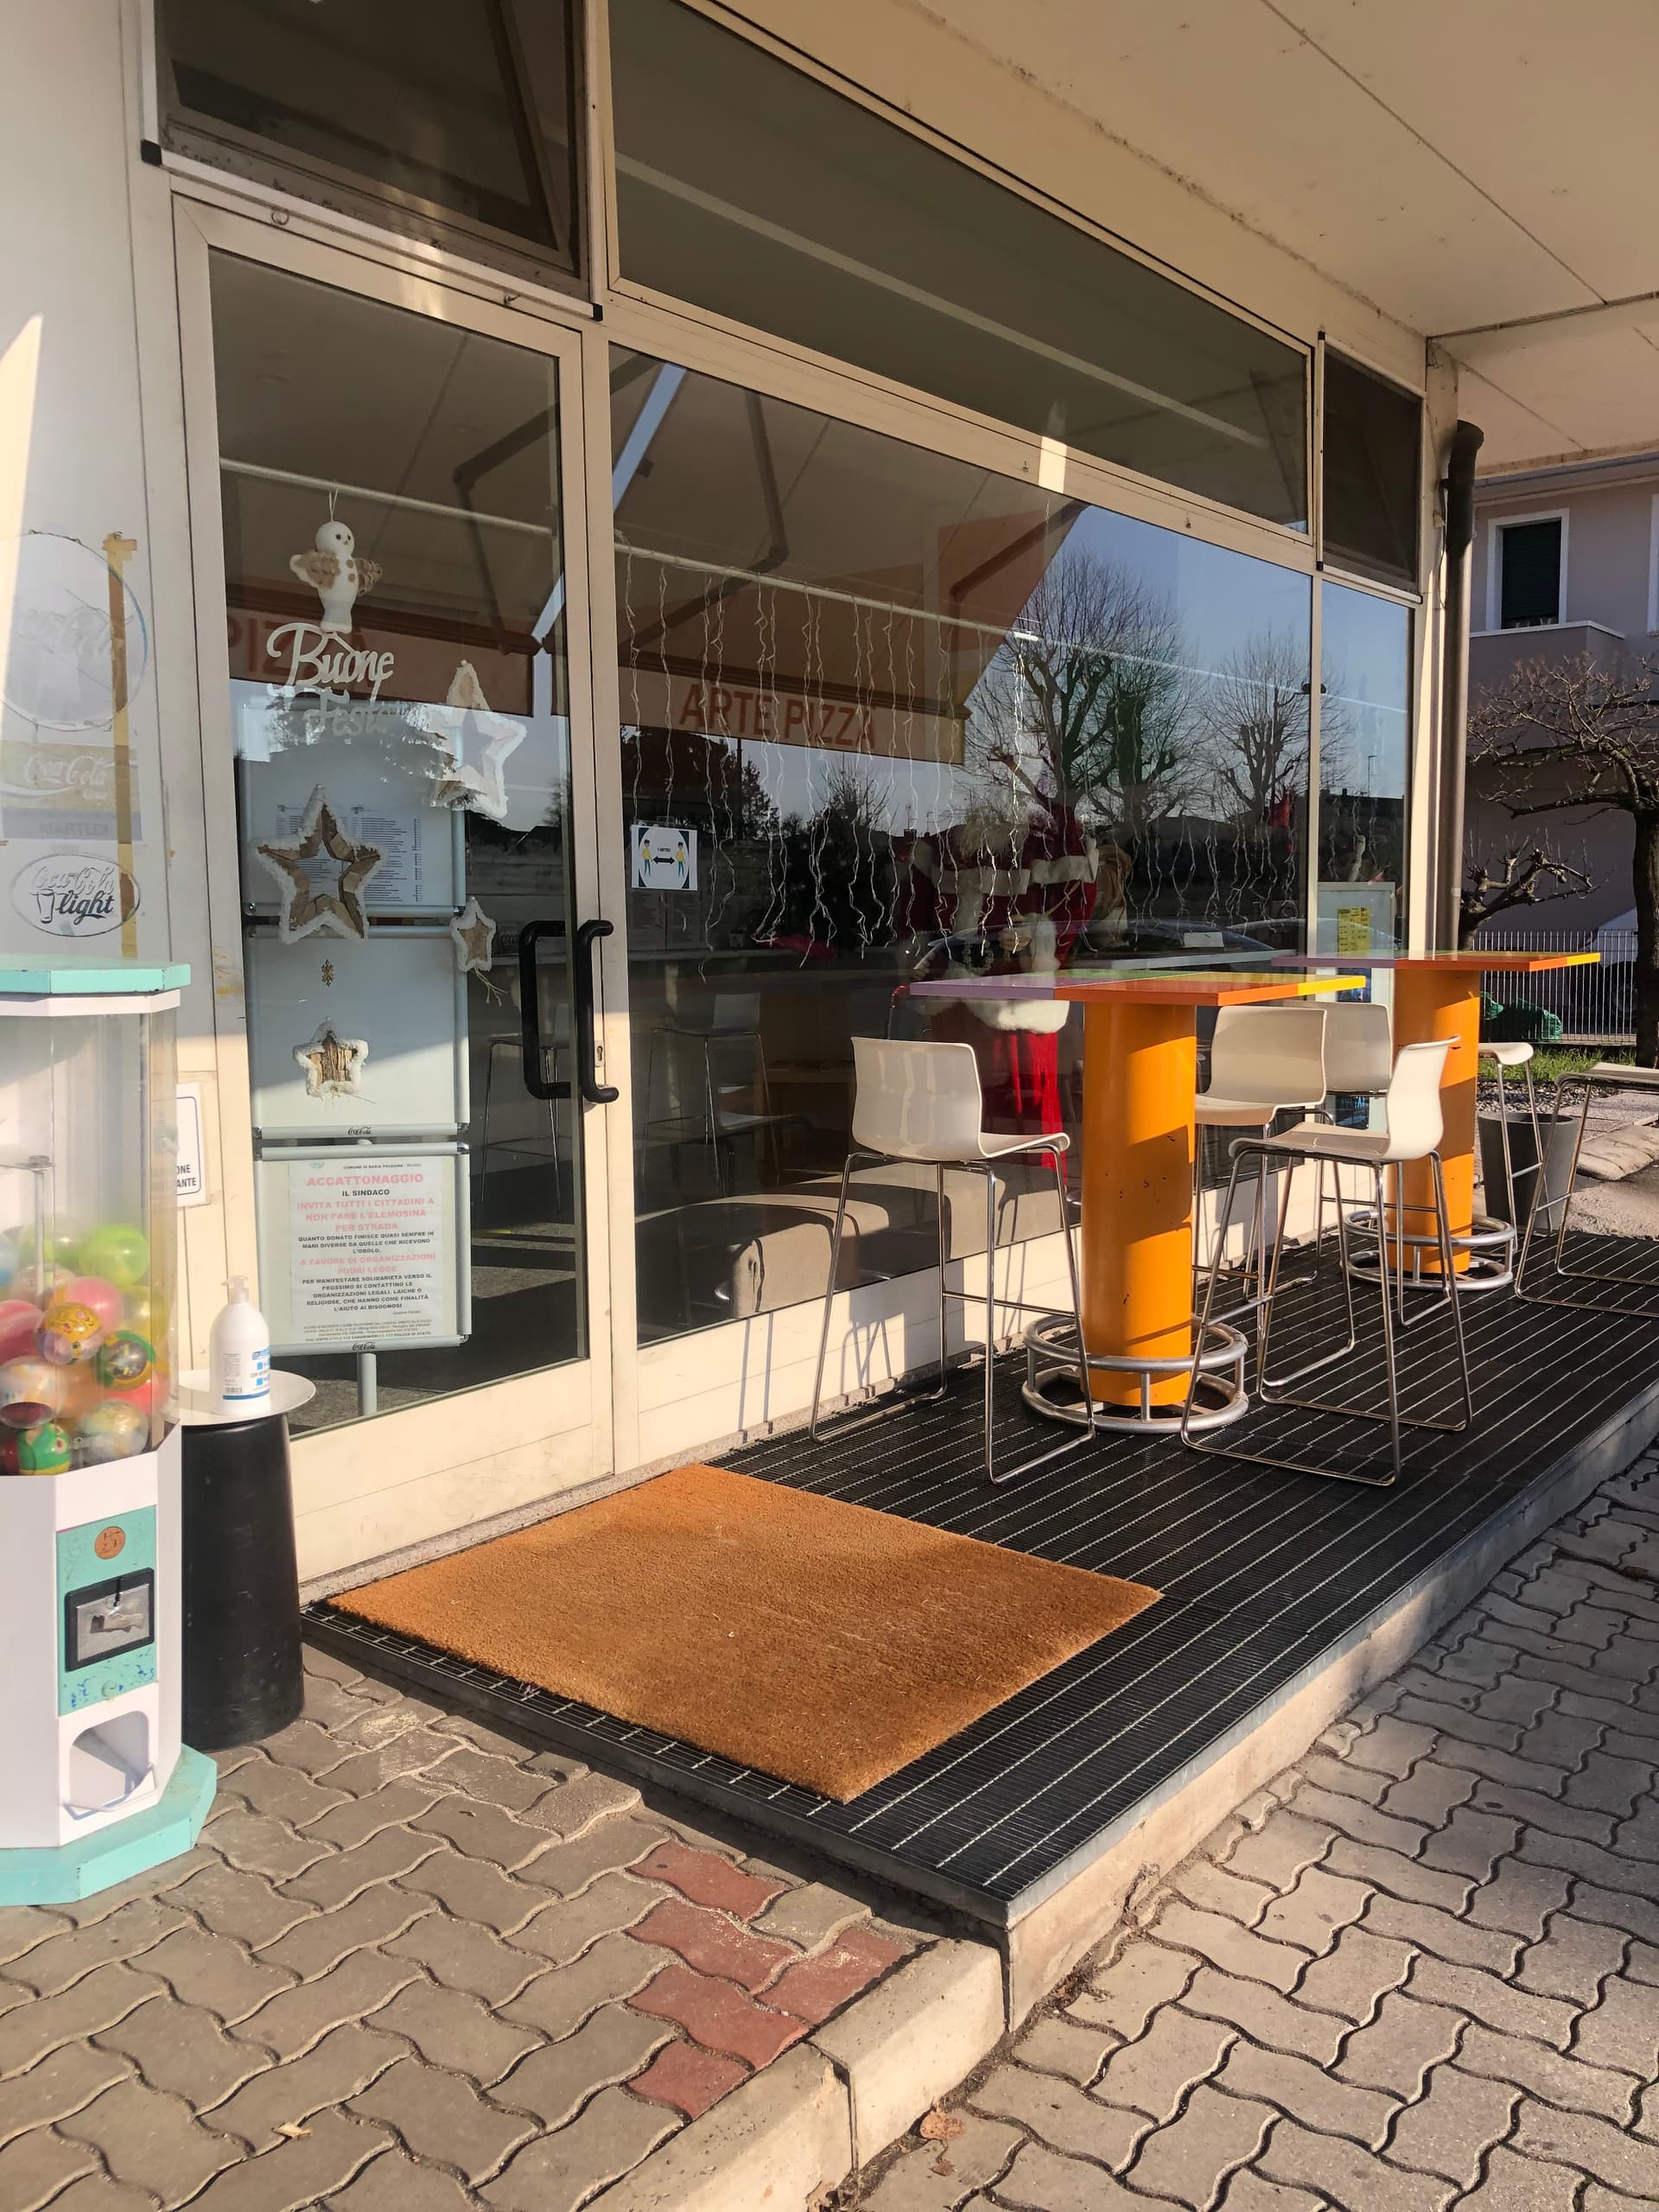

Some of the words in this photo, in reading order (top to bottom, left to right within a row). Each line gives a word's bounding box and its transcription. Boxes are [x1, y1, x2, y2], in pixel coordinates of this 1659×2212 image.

[266, 622, 395, 686] Buone
[679, 684, 772, 737] ARTE
[784, 700, 875, 749] PIZZA
[55, 890, 115, 925] light
[307, 1173, 424, 1187] ACCATTONAGGIO
[296, 1202, 332, 1211] INVITA
[334, 1199, 365, 1208] TUTTI
[373, 1197, 425, 1207] CITTADINI
[305, 1212, 328, 1222] NON
[331, 1211, 358, 1220] FARE
[334, 1224, 354, 1232] PER
[358, 1222, 399, 1231] STRADA
